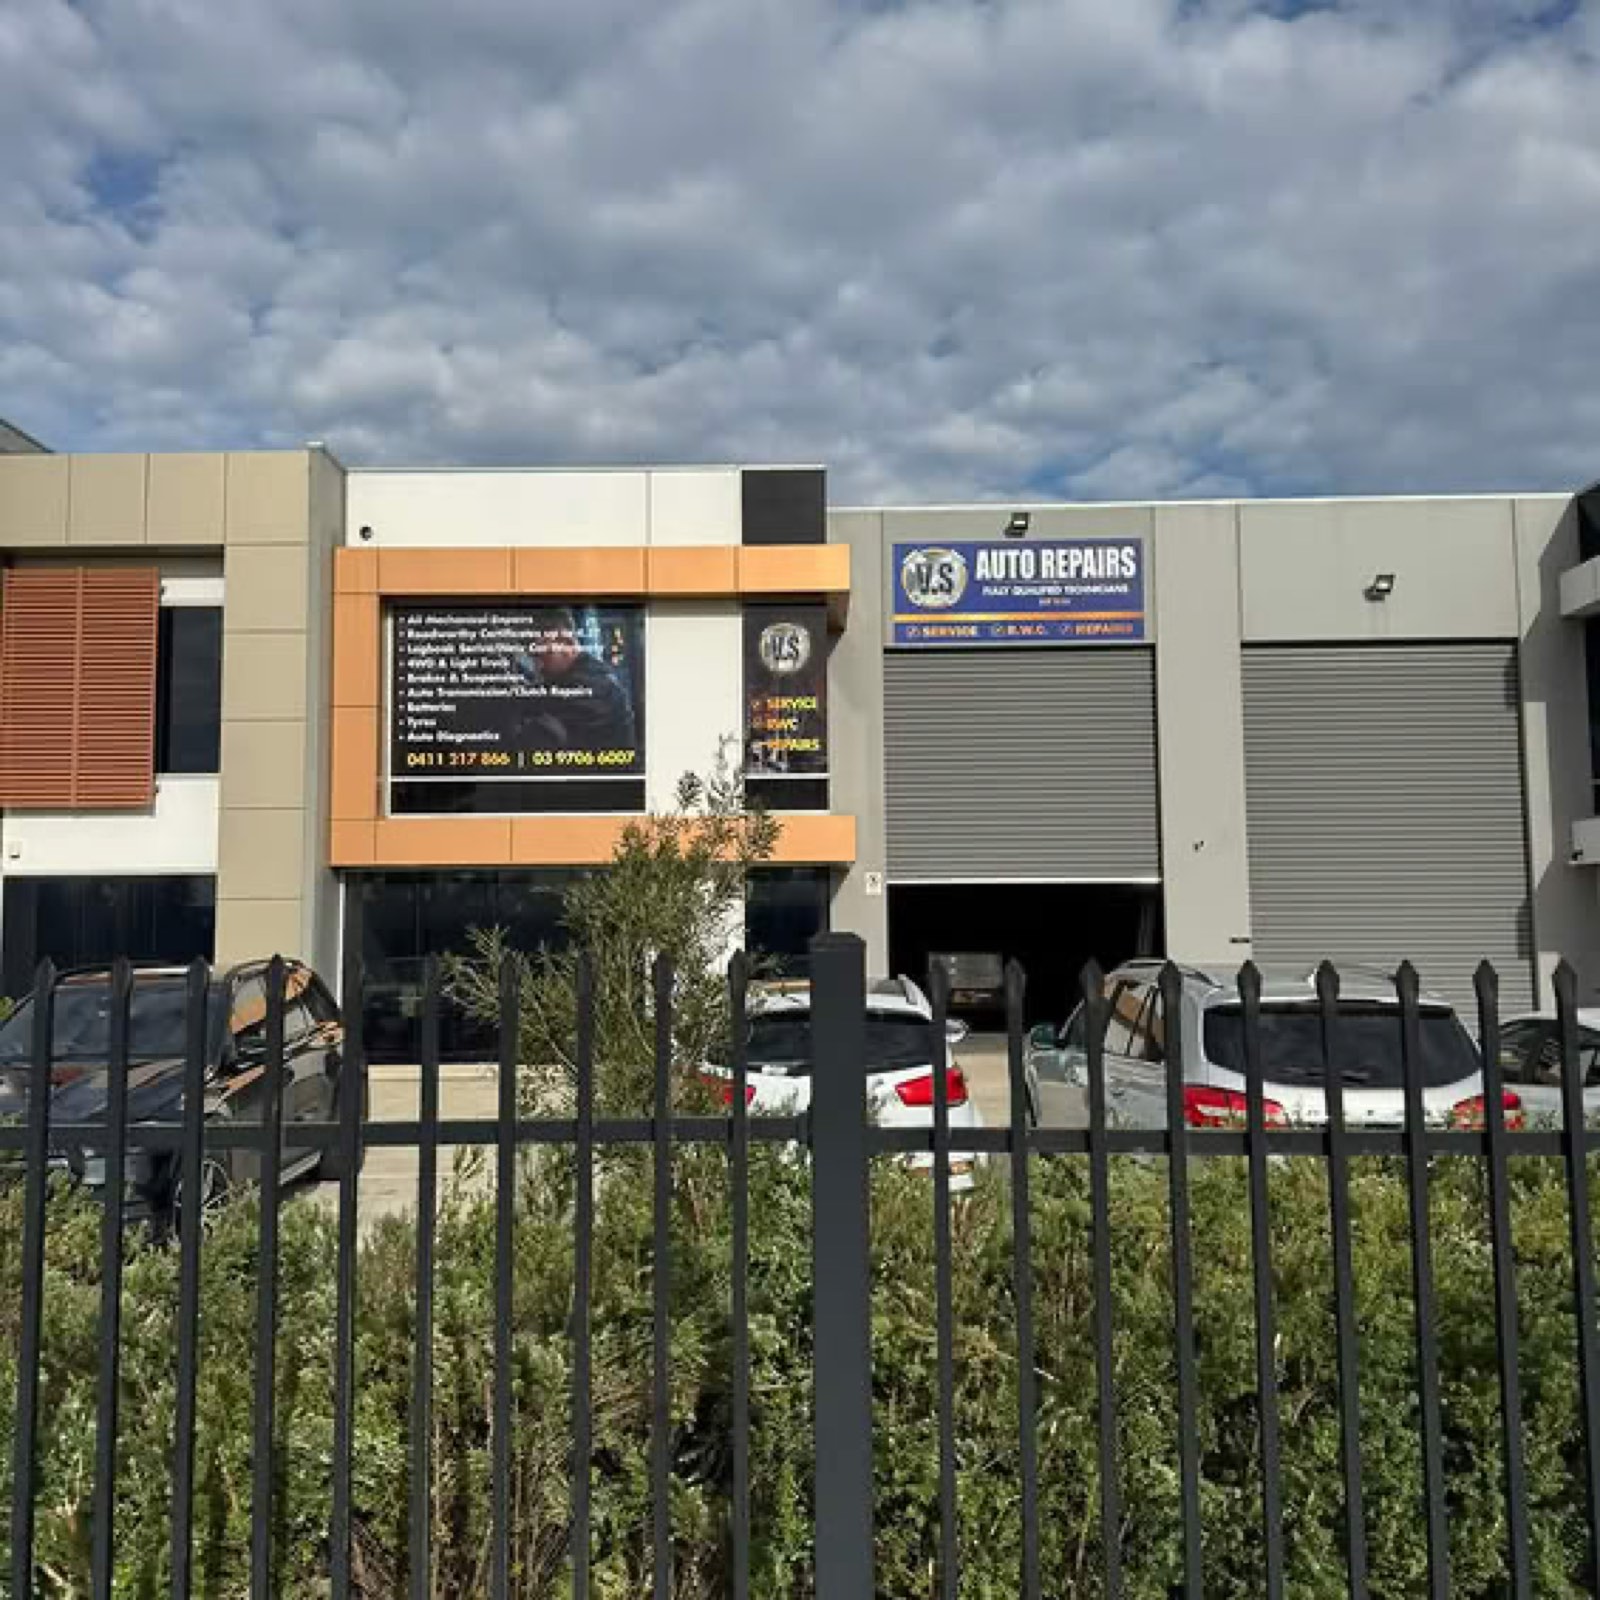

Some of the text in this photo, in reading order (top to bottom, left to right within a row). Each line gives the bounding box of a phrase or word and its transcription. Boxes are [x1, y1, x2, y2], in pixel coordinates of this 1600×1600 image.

[975, 546, 1136, 580] AUTO REPAIRS
[407, 628, 477, 640] Roadworthy
[922, 625, 978, 637] SERVICE
[450, 658, 477, 671] Light
[407, 673, 446, 683] Brakes
[407, 688, 434, 698] Auto
[551, 687, 593, 699] Repairs
[407, 702, 456, 712] Batteries
[767, 696, 817, 709] SERVICE
[407, 716, 437, 729] Tyres
[407, 730, 500, 743] Auto Diagnostics
[407, 753, 443, 766] 0411
[532, 751, 552, 765] 03
[556, 751, 594, 765] 9706
